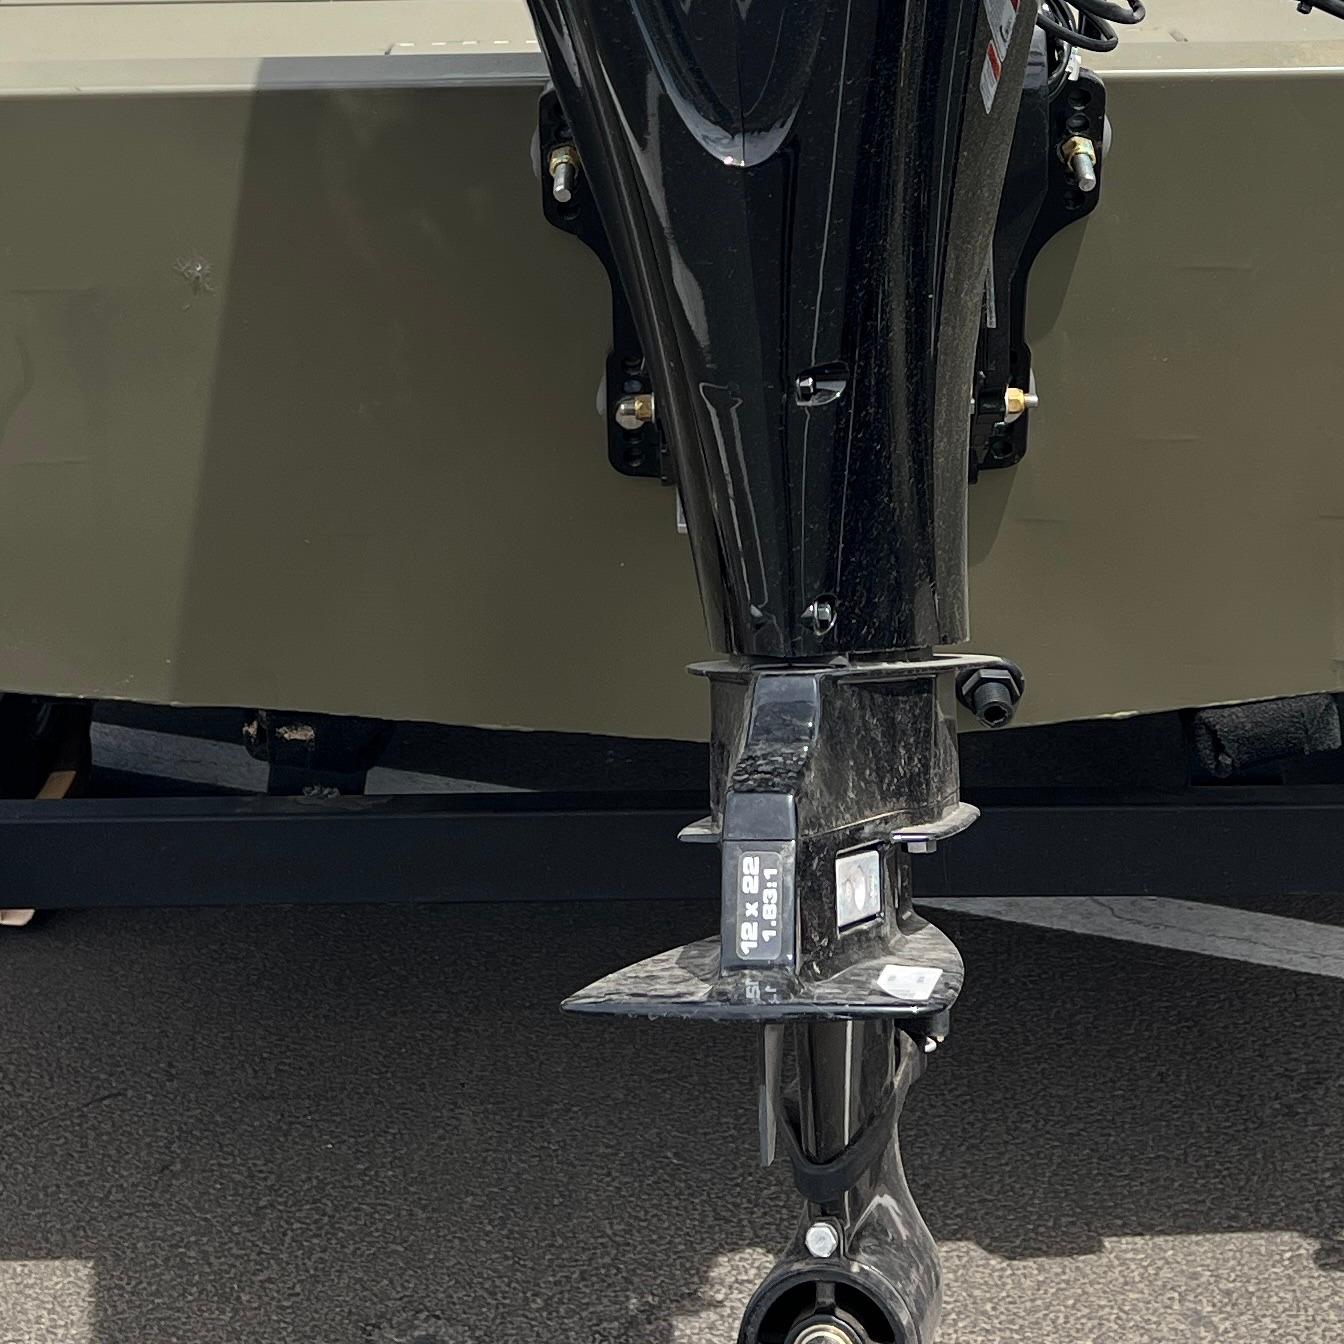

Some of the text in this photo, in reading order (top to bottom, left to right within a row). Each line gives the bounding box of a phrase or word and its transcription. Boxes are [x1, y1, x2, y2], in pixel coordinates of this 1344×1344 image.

[741, 856, 760, 955] 12 x 22
[762, 868, 777, 942] 1.83:1
